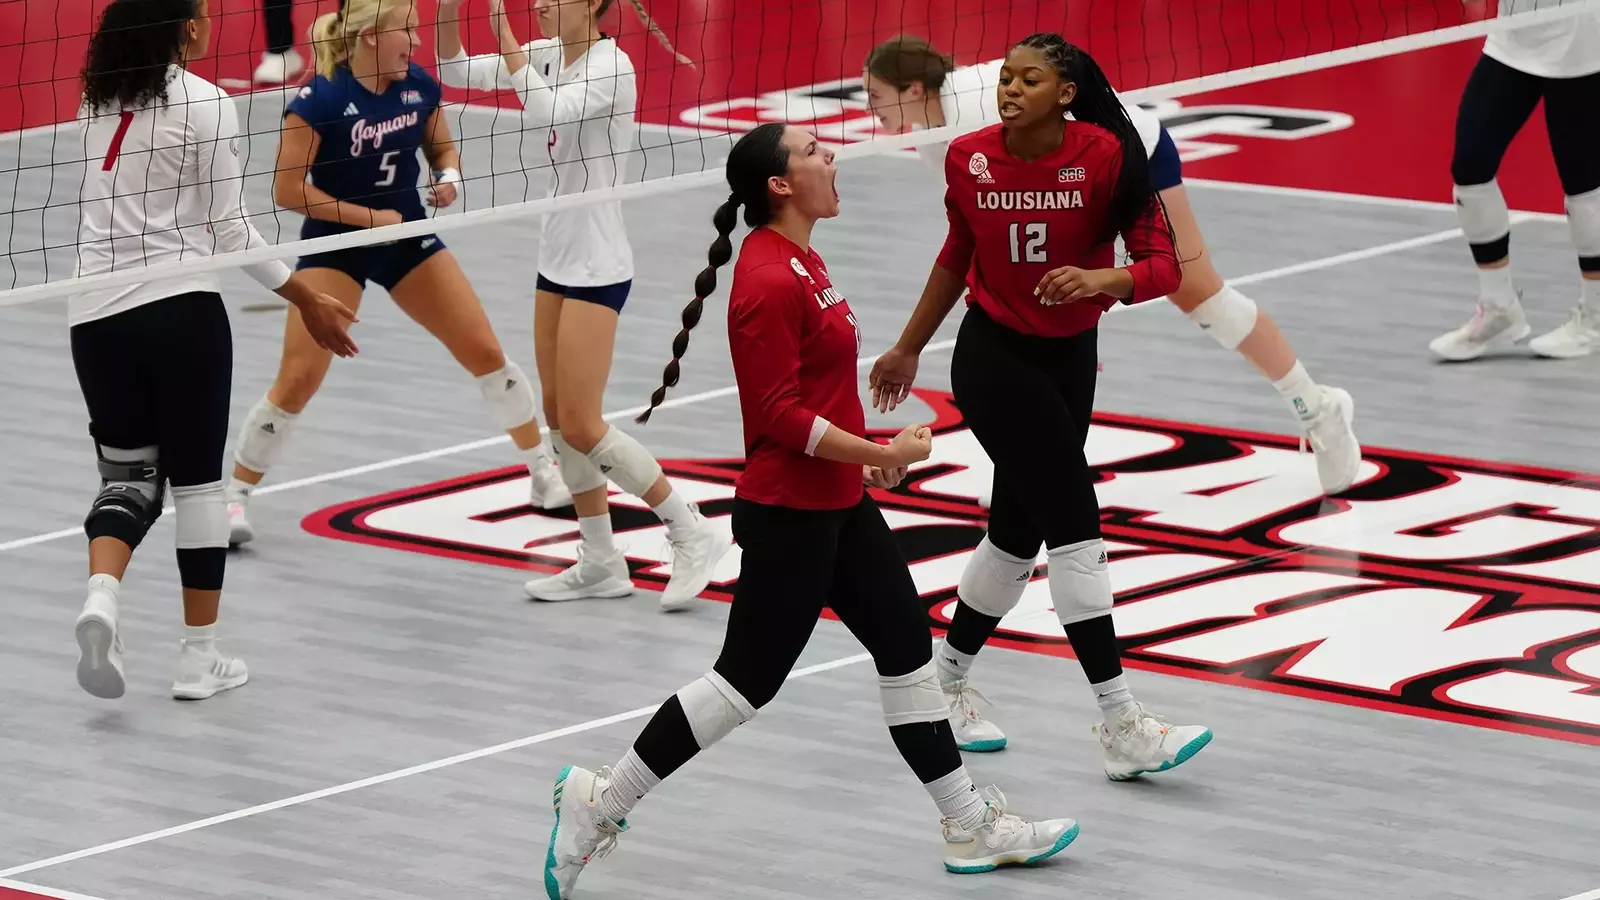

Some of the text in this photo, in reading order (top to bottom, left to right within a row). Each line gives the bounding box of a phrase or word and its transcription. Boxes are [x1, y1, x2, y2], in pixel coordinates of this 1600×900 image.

[350, 111, 418, 157] Jaguars
[374, 150, 400, 187] 5
[1058, 167, 1085, 183] SBC
[976, 190, 1084, 210] LOUISIANA
[1009, 222, 1048, 263] 12
